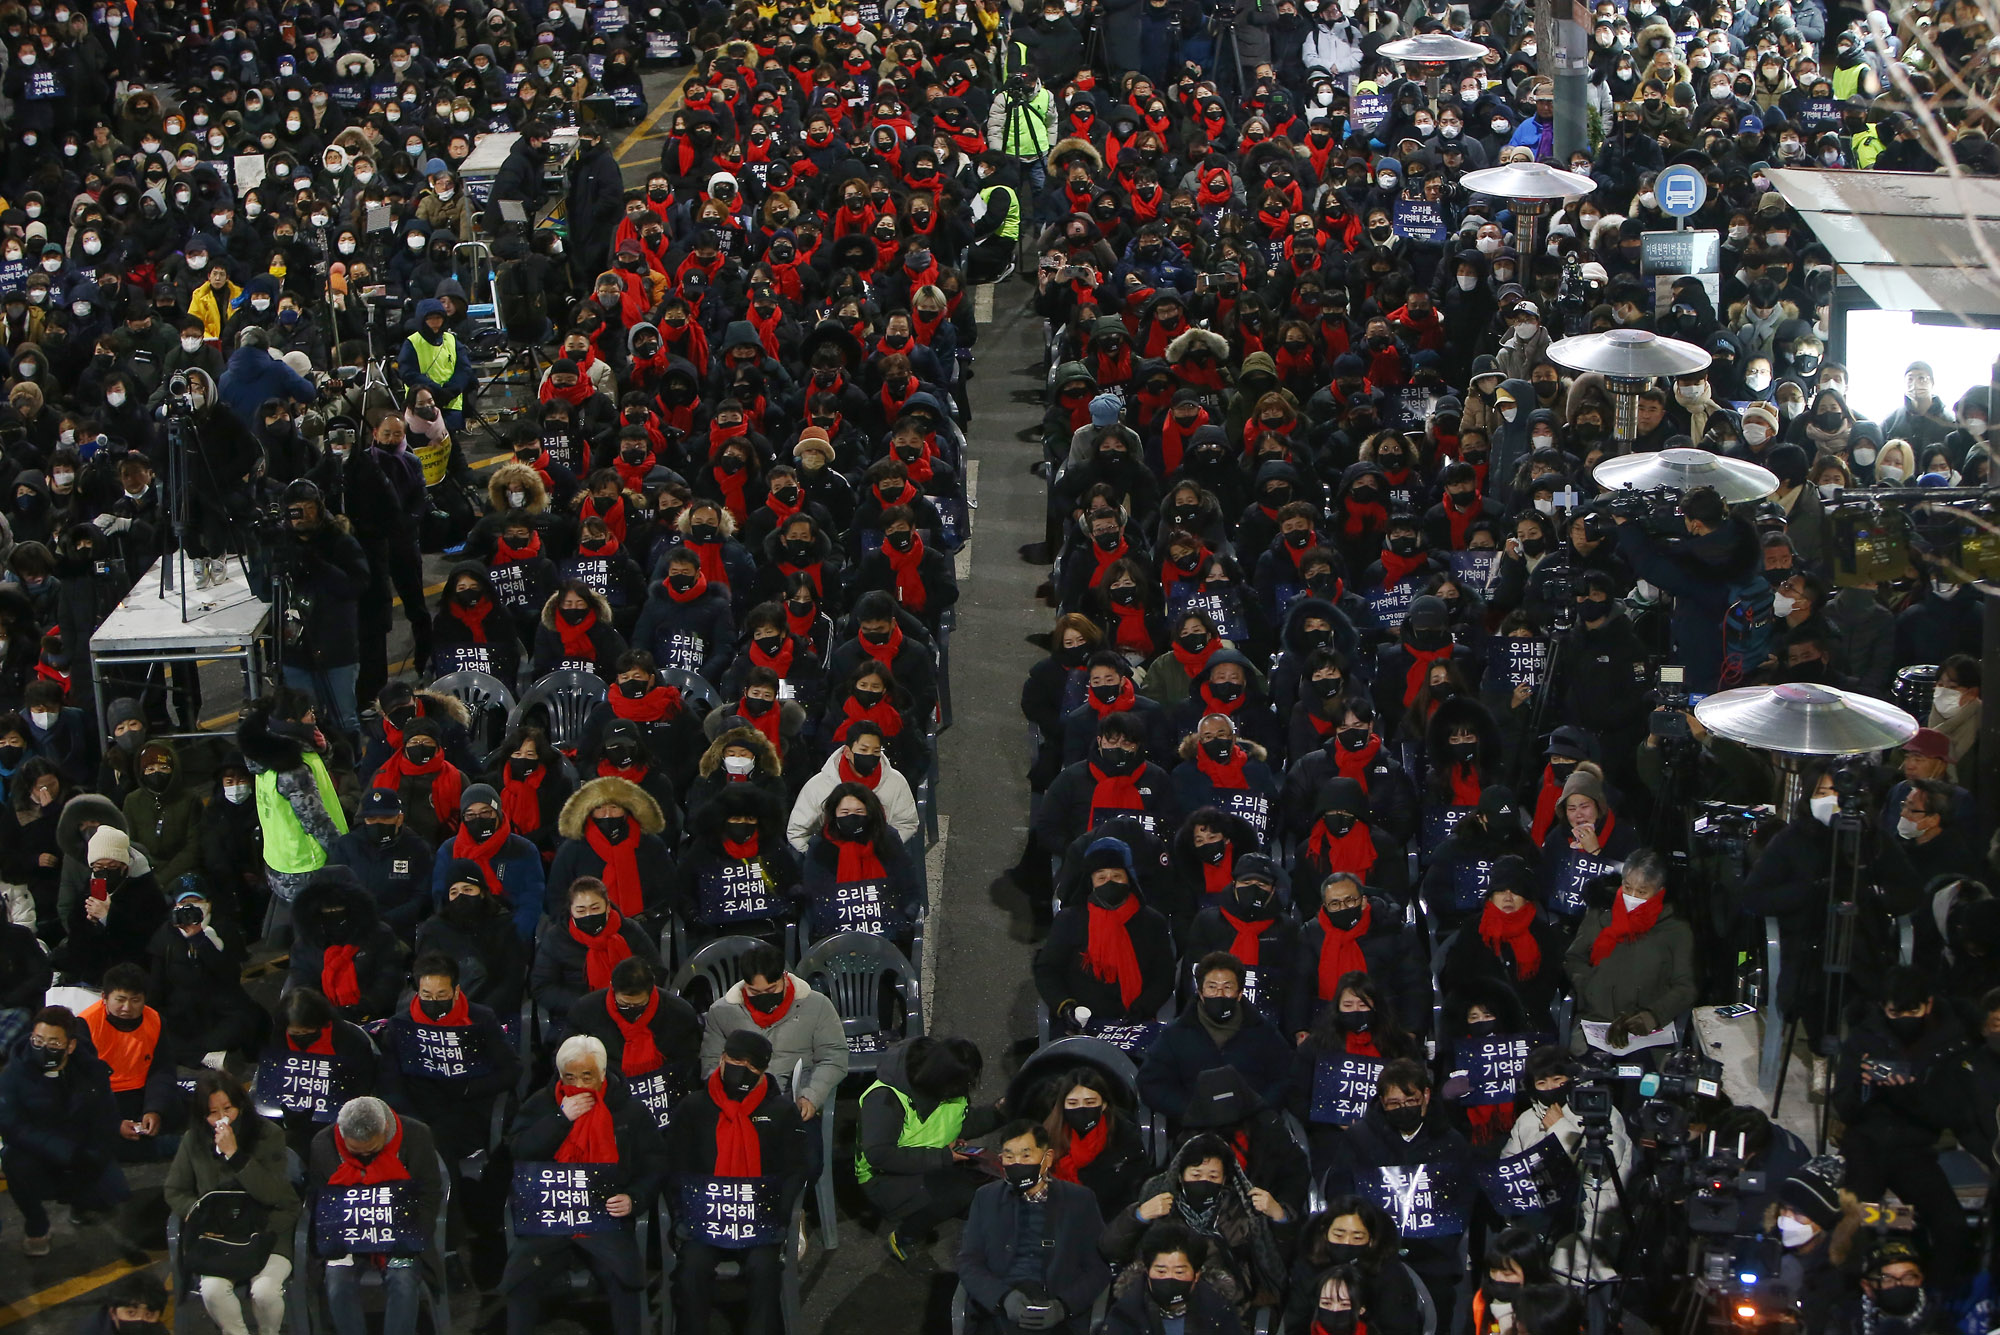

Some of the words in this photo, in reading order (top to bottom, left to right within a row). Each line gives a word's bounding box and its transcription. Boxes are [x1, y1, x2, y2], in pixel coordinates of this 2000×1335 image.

[1353, 107, 1369, 116] 기억해
[1370, 106, 1388, 114] 주세요
[1361, 98, 1379, 106] 우리를
[1812, 103, 1831, 111] 우리를
[1803, 111, 1821, 120] 기억해
[752, 165, 767, 173] 우리
[1411, 205, 1432, 214] 우리를
[1398, 214, 1420, 224] 기억해
[1421, 214, 1443, 225] 주세요
[4, 263, 23, 272] 우리를
[1200, 394, 1219, 405] 리를
[1400, 387, 1431, 399] 우리를
[547, 448, 570, 461] 억해
[1389, 490, 1411, 502] 리를
[490, 565, 522, 583] 우리를
[576, 560, 608, 574] 우리를
[1457, 569, 1486, 583] 기억해
[500, 594, 528, 606] 세요
[1370, 595, 1398, 612] 기억해
[1378, 614, 1393, 622] 10.29
[671, 633, 704, 652] 우리를
[1509, 642, 1547, 656] 우리를
[455, 647, 490, 662] 우리를
[670, 649, 703, 666] 기억해
[456, 660, 491, 675] 기억해
[559, 660, 596, 674] 우리를
[1230, 794, 1269, 814] 우리를
[1230, 811, 1268, 830] 억해
[721, 862, 763, 882] 우리를
[723, 879, 766, 898] 기억해
[836, 885, 880, 904] 우리를
[723, 898, 768, 915] 주세요
[837, 902, 881, 922] 기억해
[417, 1028, 460, 1047] 우리를
[419, 1043, 464, 1061] 기억해
[1481, 1039, 1530, 1061] 우리를
[284, 1057, 331, 1078] 우리를
[424, 1058, 468, 1077] 주세요
[1340, 1060, 1384, 1082] 우리를
[283, 1076, 330, 1096] 기억해
[1336, 1099, 1368, 1118] 주세
[539, 1169, 589, 1188] 우리를
[1380, 1171, 1432, 1192] 우리를
[343, 1186, 393, 1205] 우리를
[540, 1189, 590, 1208] 기억해
[705, 1183, 756, 1202] 우리를
[343, 1206, 393, 1225] 기억해
[540, 1209, 592, 1228] 주세요
[706, 1202, 755, 1221] 기억해
[344, 1226, 396, 1245] 주세요
[706, 1221, 756, 1241] 주세요
